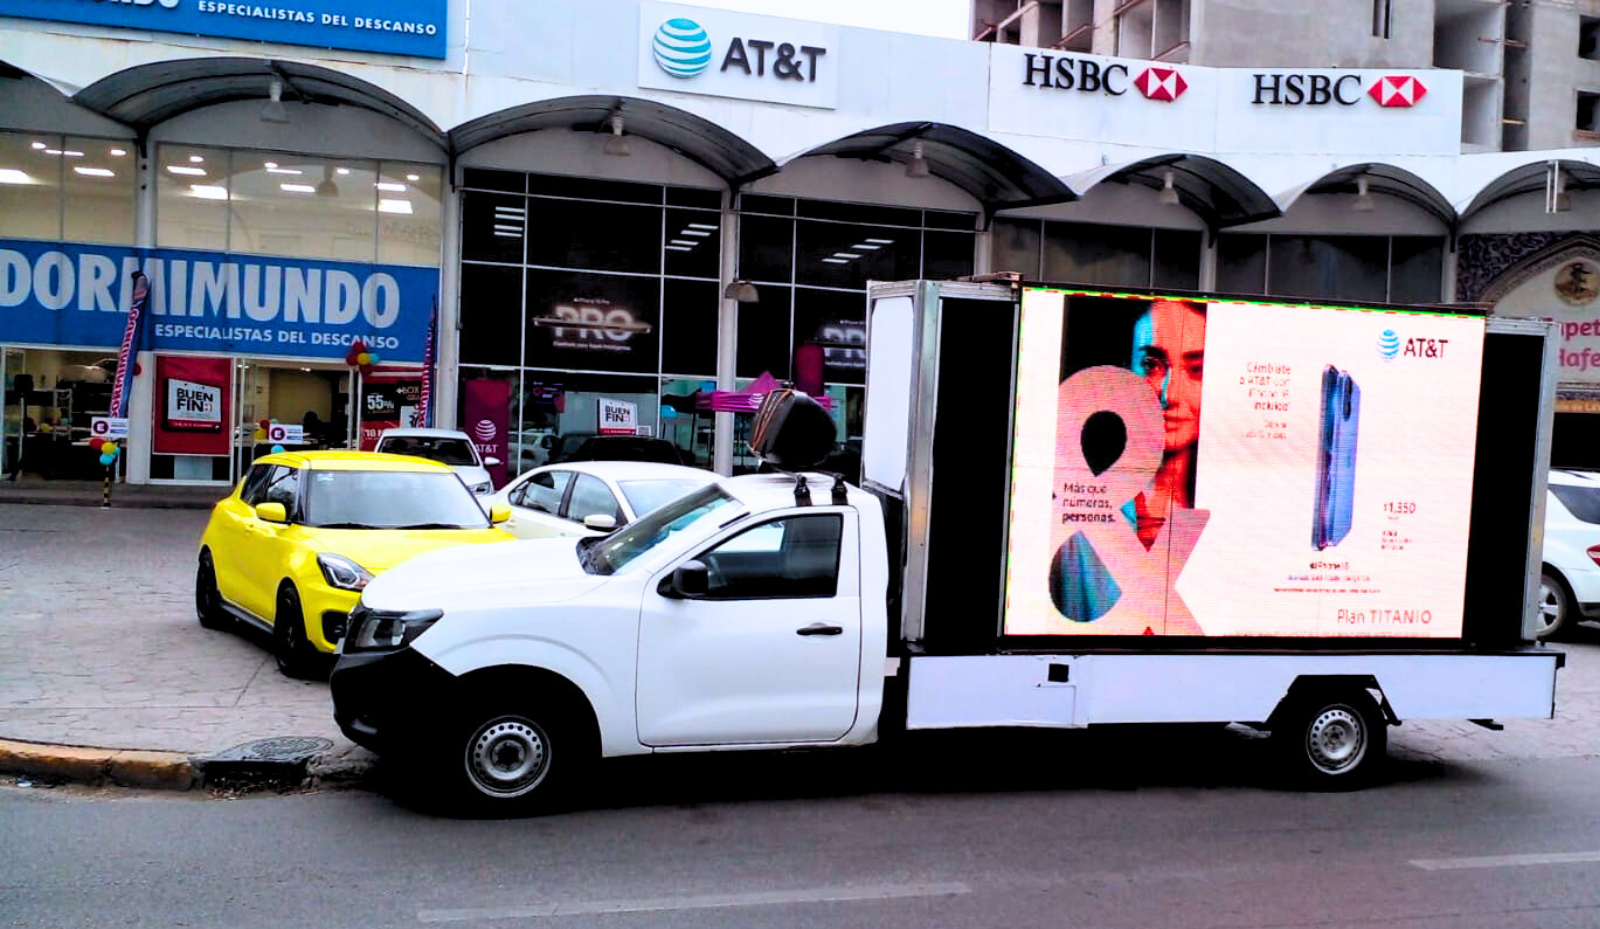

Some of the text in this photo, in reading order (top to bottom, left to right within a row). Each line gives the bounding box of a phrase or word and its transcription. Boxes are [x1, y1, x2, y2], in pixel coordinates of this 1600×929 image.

[198, 2, 315, 23] ESPECIALISTAS
[321, 13, 349, 26] DEL
[354, 17, 437, 35] DESCANSO
[720, 37, 827, 83] AT&T
[1022, 53, 1129, 96] HSBC
[1251, 74, 1363, 106] HSBC
[155, 323, 399, 350] ESPECIALISTAS DEL DESCANSO
[1403, 337, 1449, 358] AT&T
[177, 387, 214, 402] BUEN
[605, 404, 631, 415] BUEN
[1336, 608, 1433, 625] Plan TITANIO
